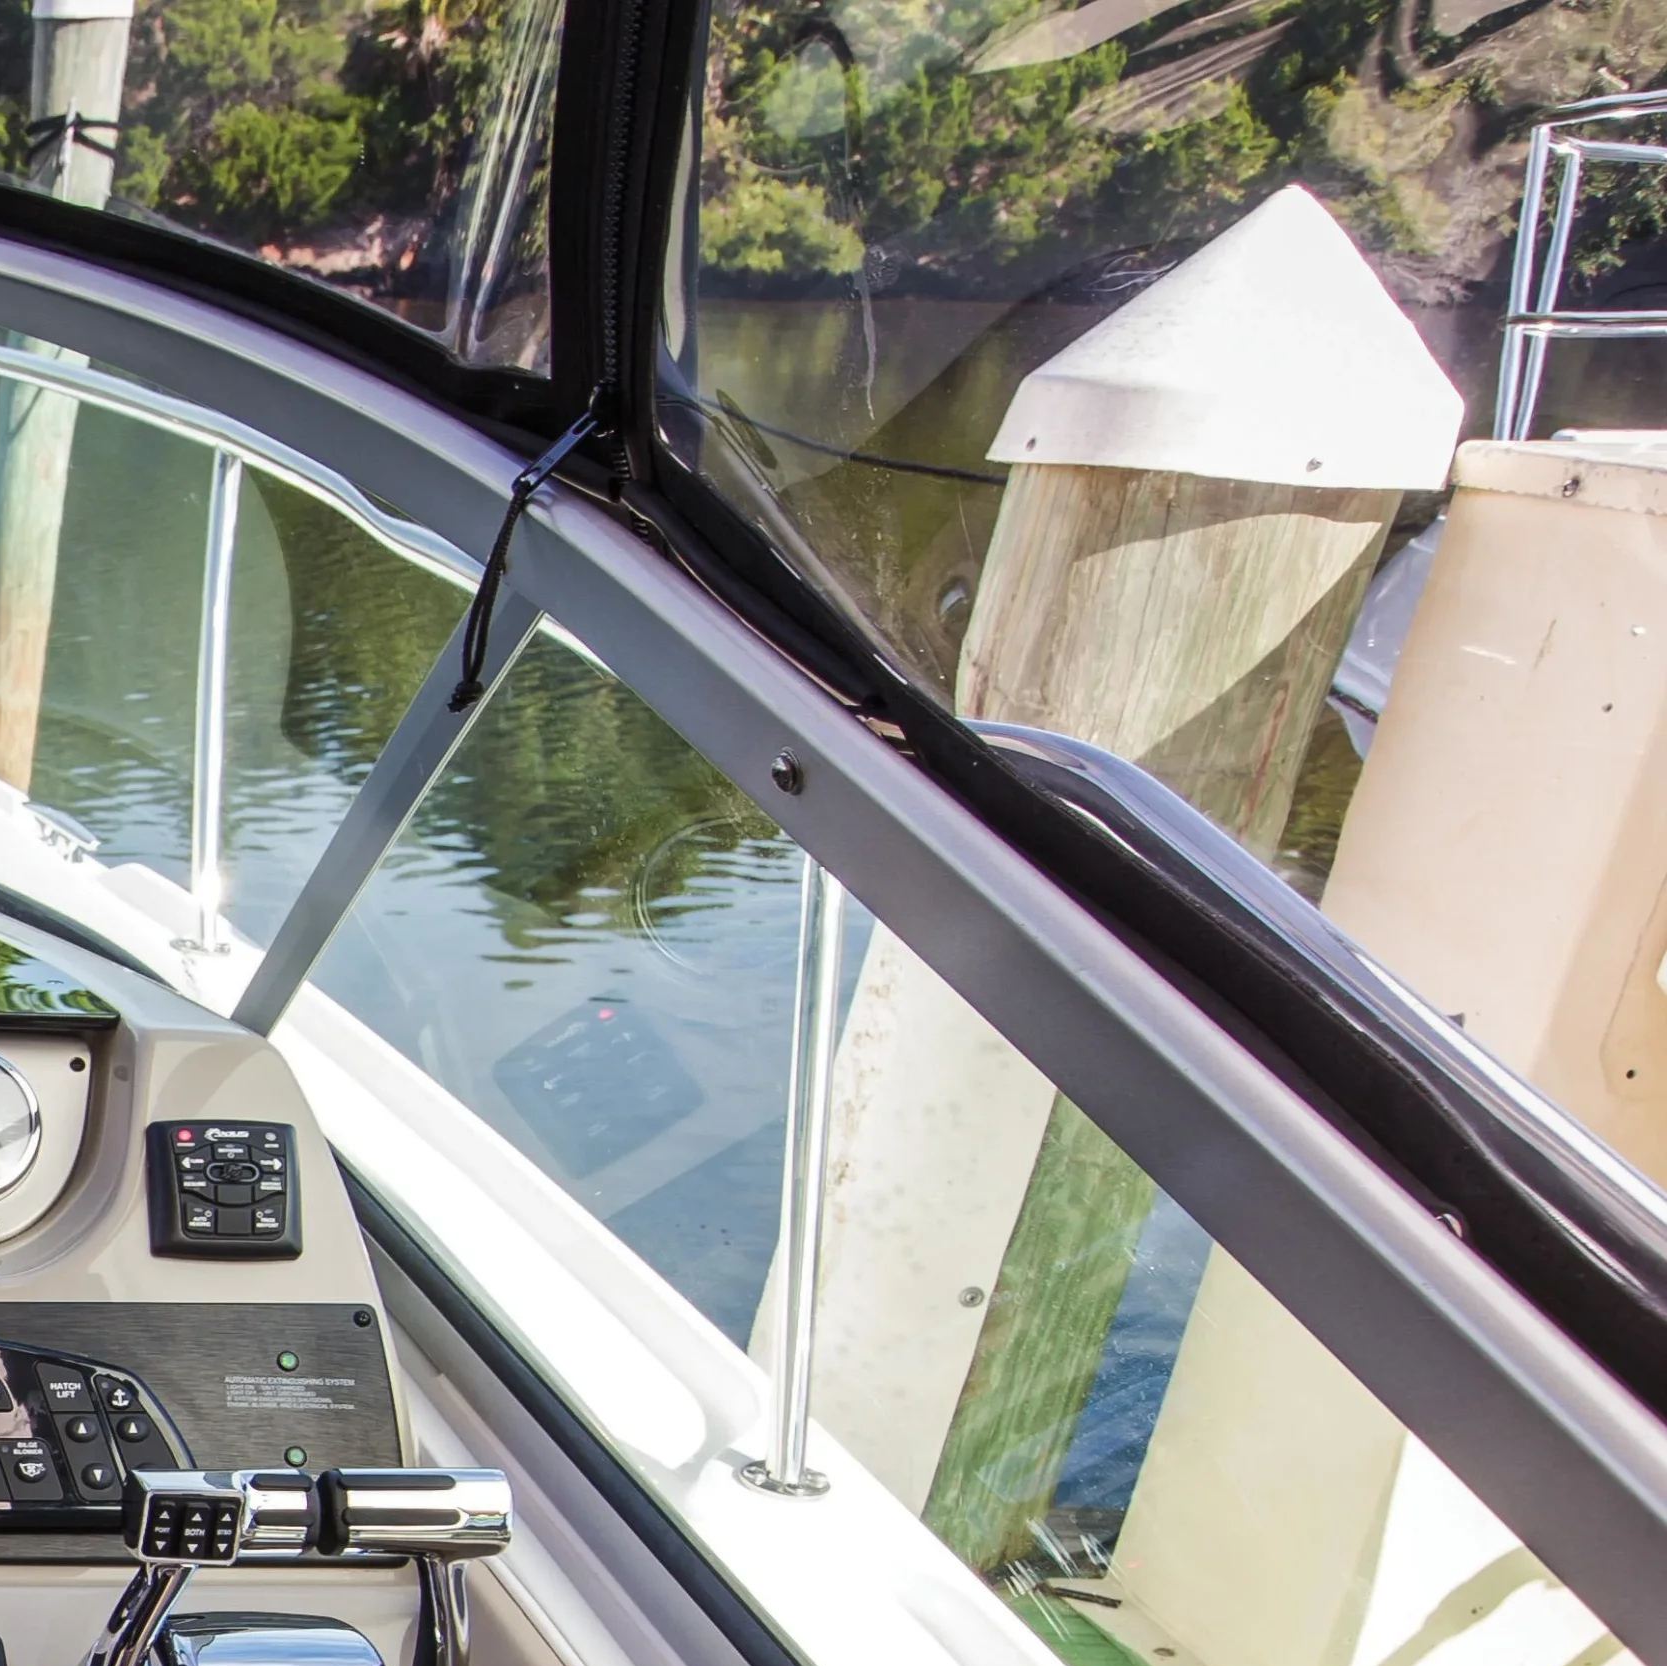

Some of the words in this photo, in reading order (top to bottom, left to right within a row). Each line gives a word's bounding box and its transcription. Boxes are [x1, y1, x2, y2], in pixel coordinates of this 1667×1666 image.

[225, 1376, 266, 1384] AUTOMATIC
[325, 1378, 355, 1386] SYSTEM
[50, 1382, 81, 1390] HATCH
